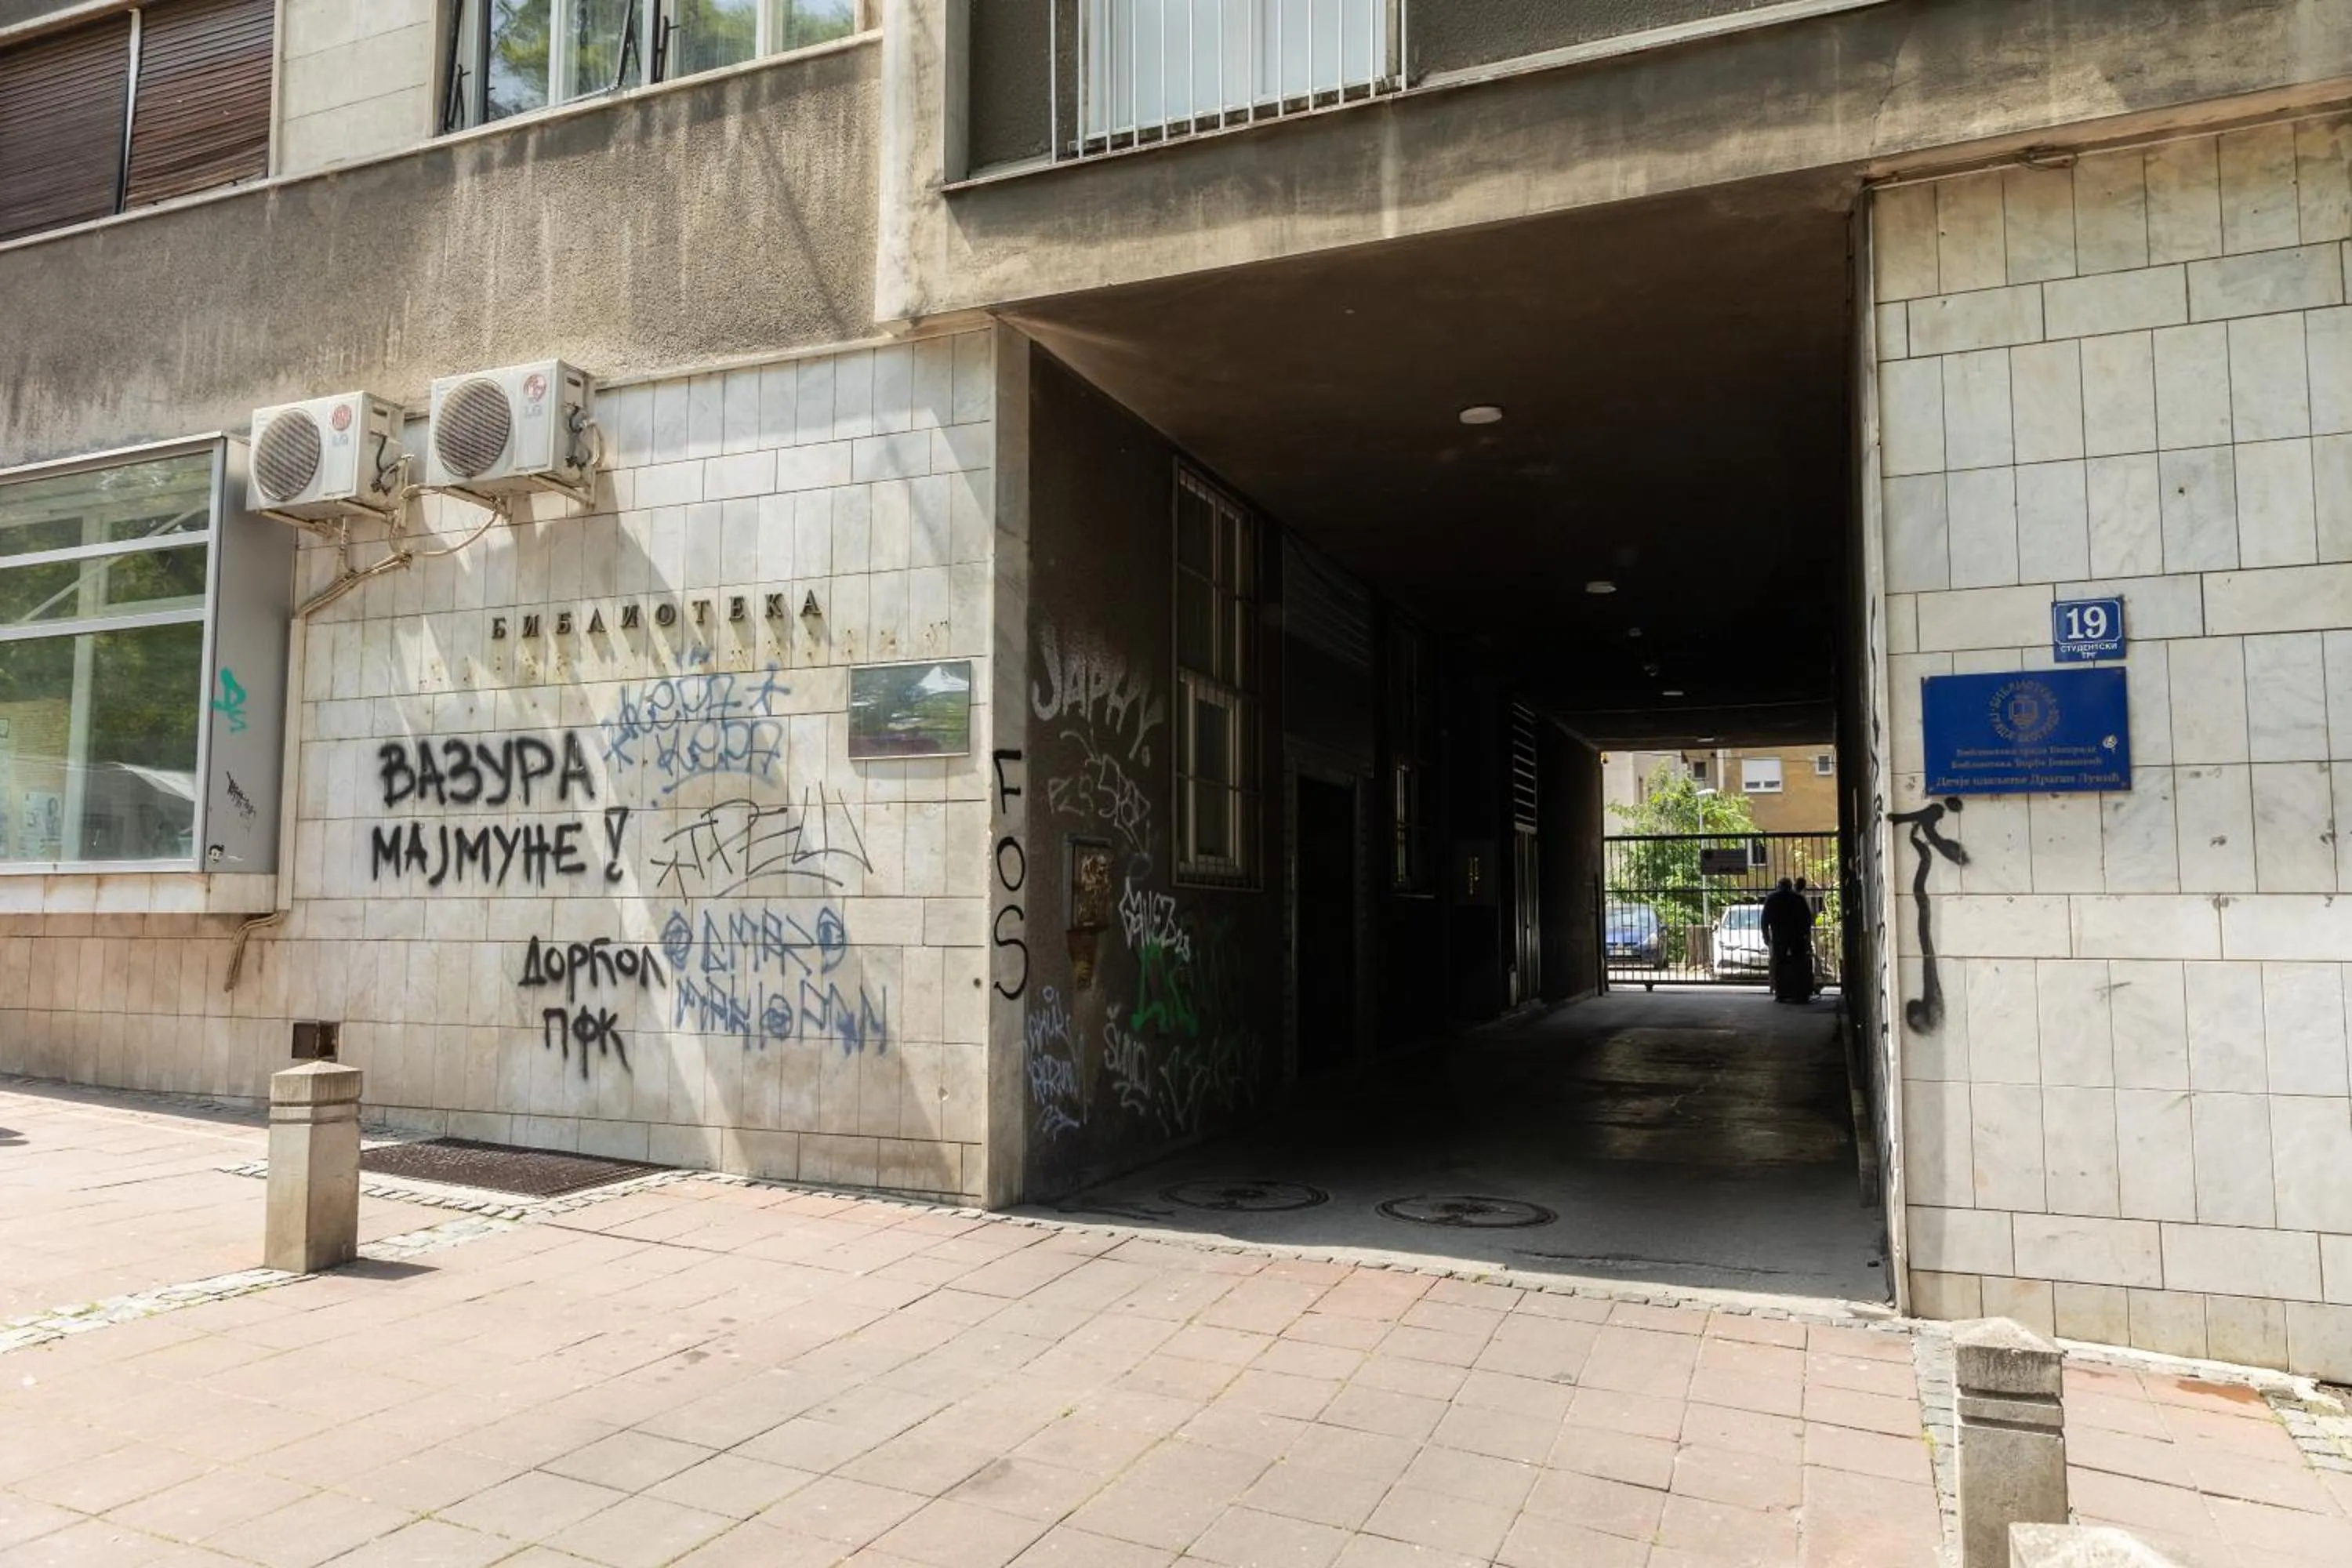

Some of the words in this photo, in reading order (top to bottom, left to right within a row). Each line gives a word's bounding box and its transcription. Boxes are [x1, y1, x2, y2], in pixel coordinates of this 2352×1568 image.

[492, 589, 822, 641] БИБЛИОТЕКА
[2066, 606, 2107, 639] 19
[378, 730, 597, 808] ВАЗУРА
